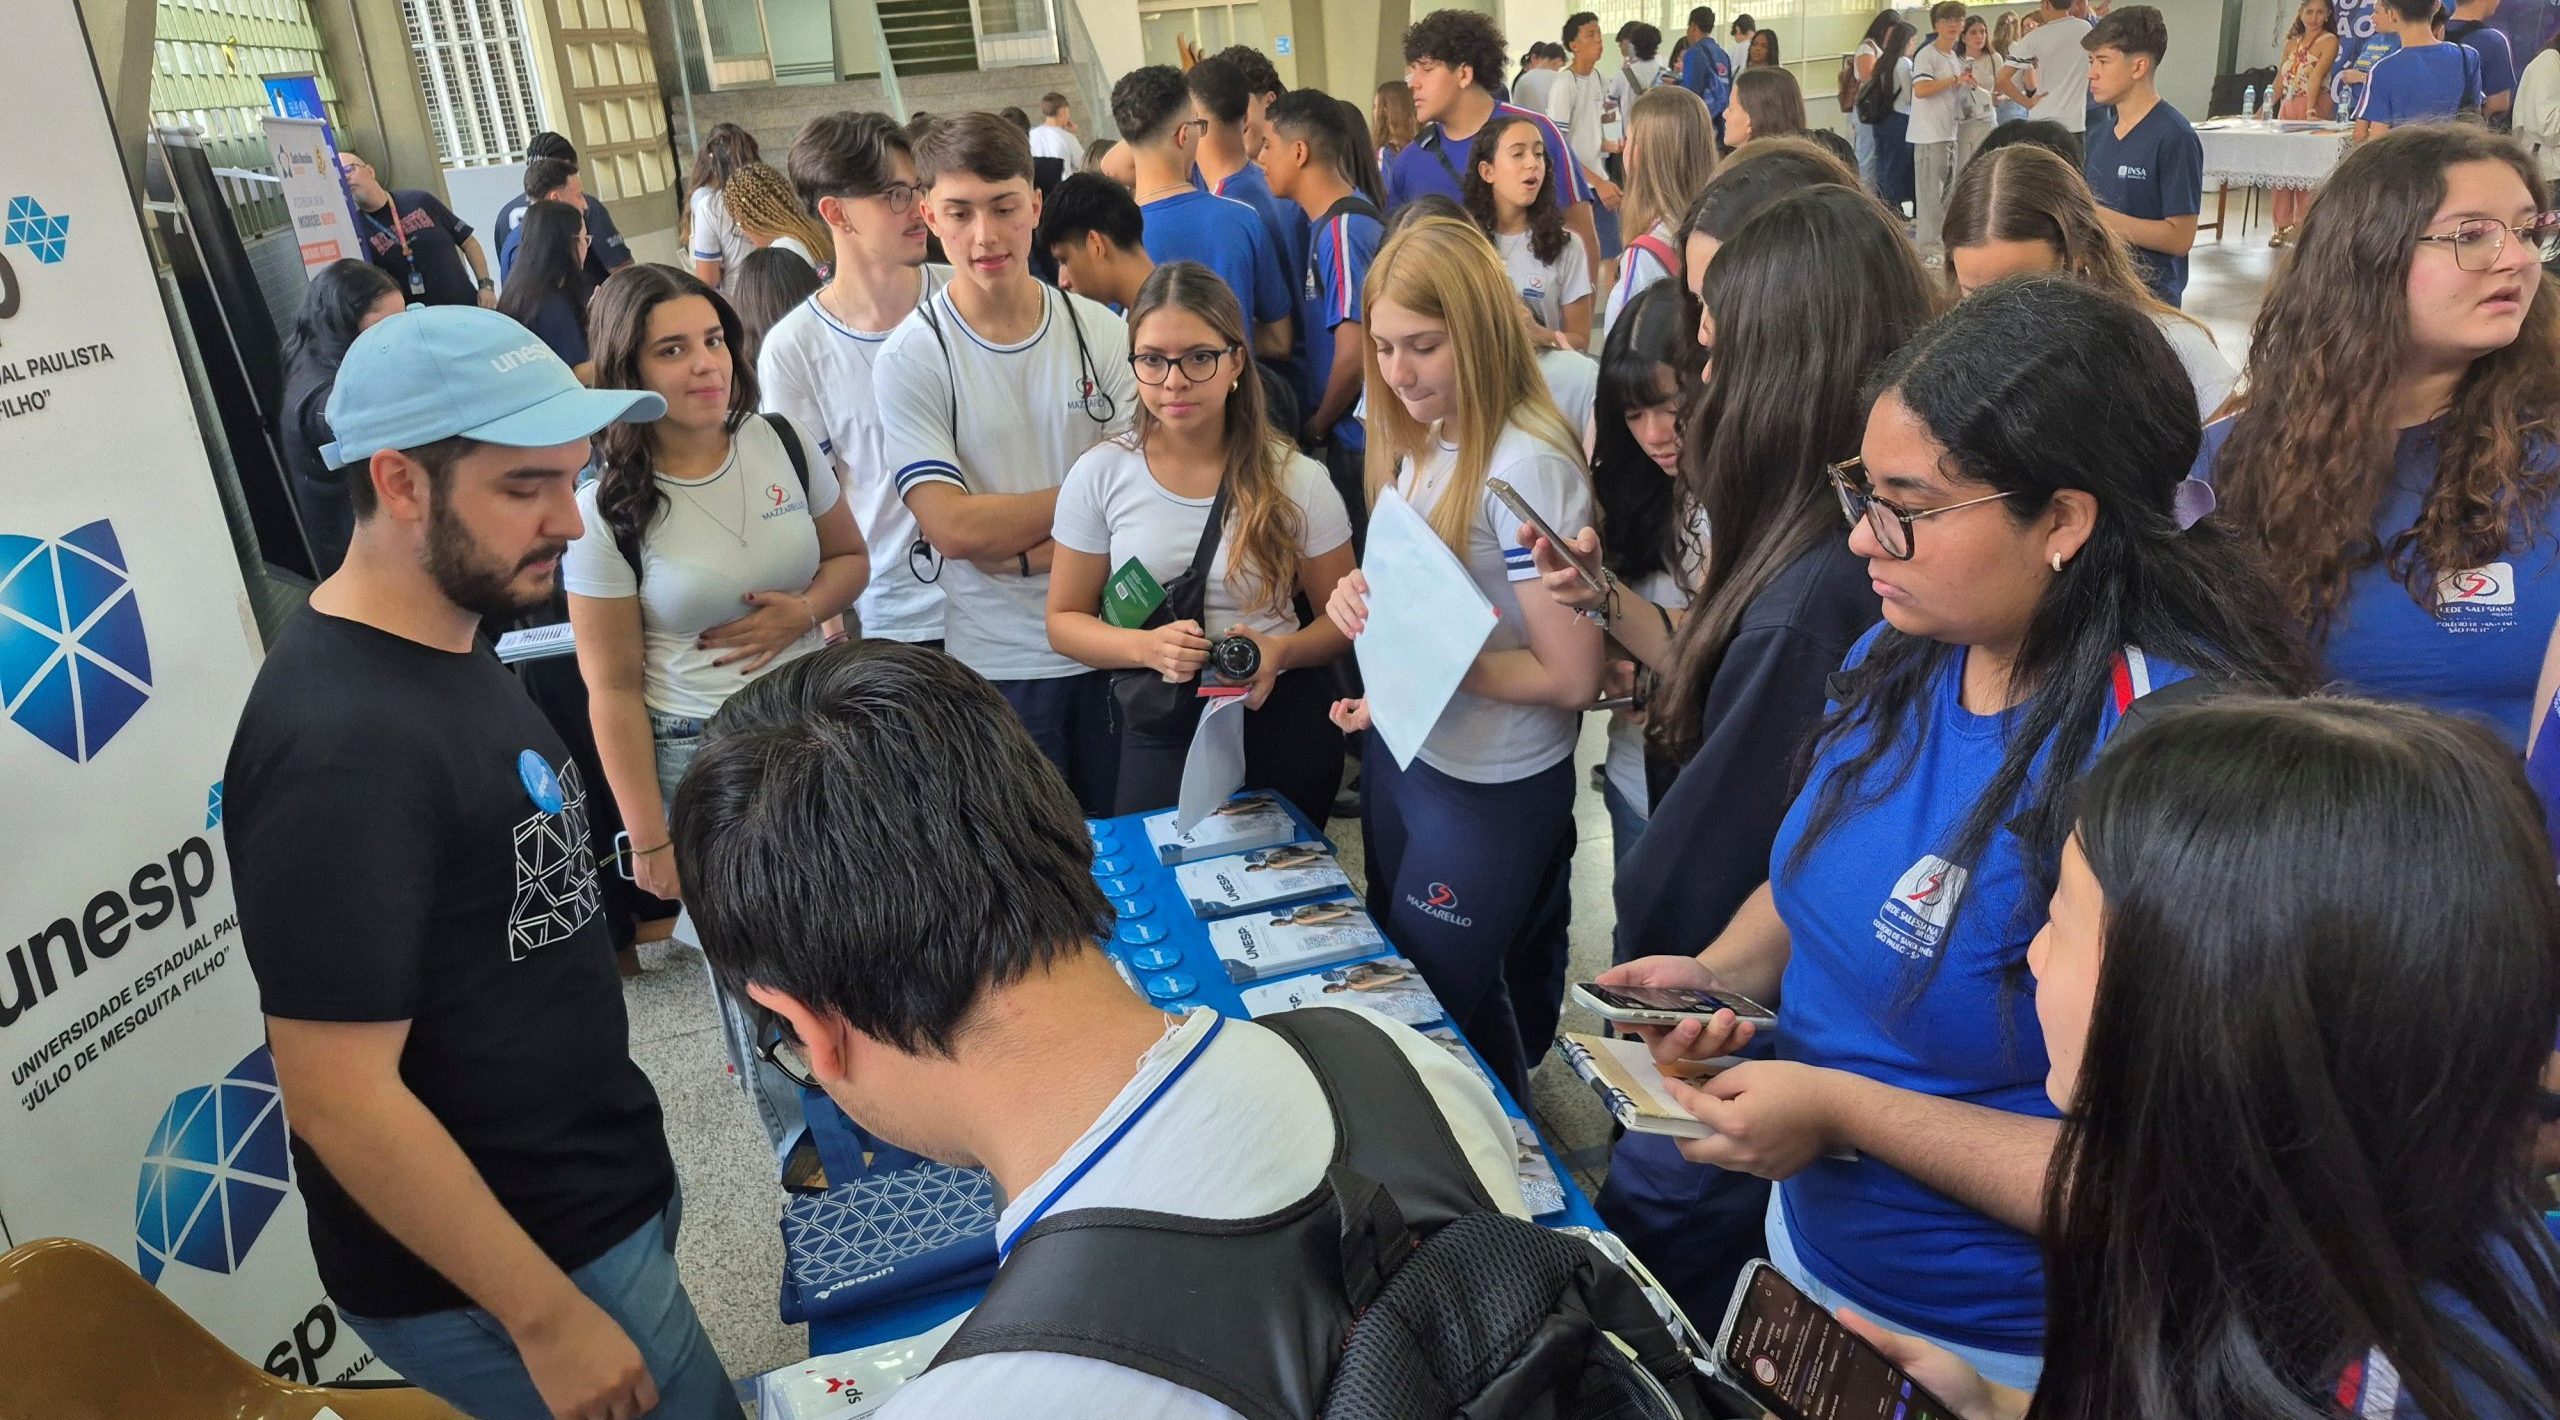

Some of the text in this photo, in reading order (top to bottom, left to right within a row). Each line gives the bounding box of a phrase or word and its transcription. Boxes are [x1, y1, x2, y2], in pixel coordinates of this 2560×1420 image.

[26, 343, 114, 378] PAULISTA
[490, 338, 553, 373] unes
[1406, 894, 1472, 927] MAZZARELLO
[1900, 910, 1940, 935] SALESIANA
[0, 836, 214, 1028] unesp
[11, 986, 133, 1087] UNIVERSIDADE
[135, 932, 212, 996] ESTADUAL
[21, 945, 230, 1112] “JÚLIO DE MESQUITA FILHO”
[830, 1266, 895, 1291] unesp
